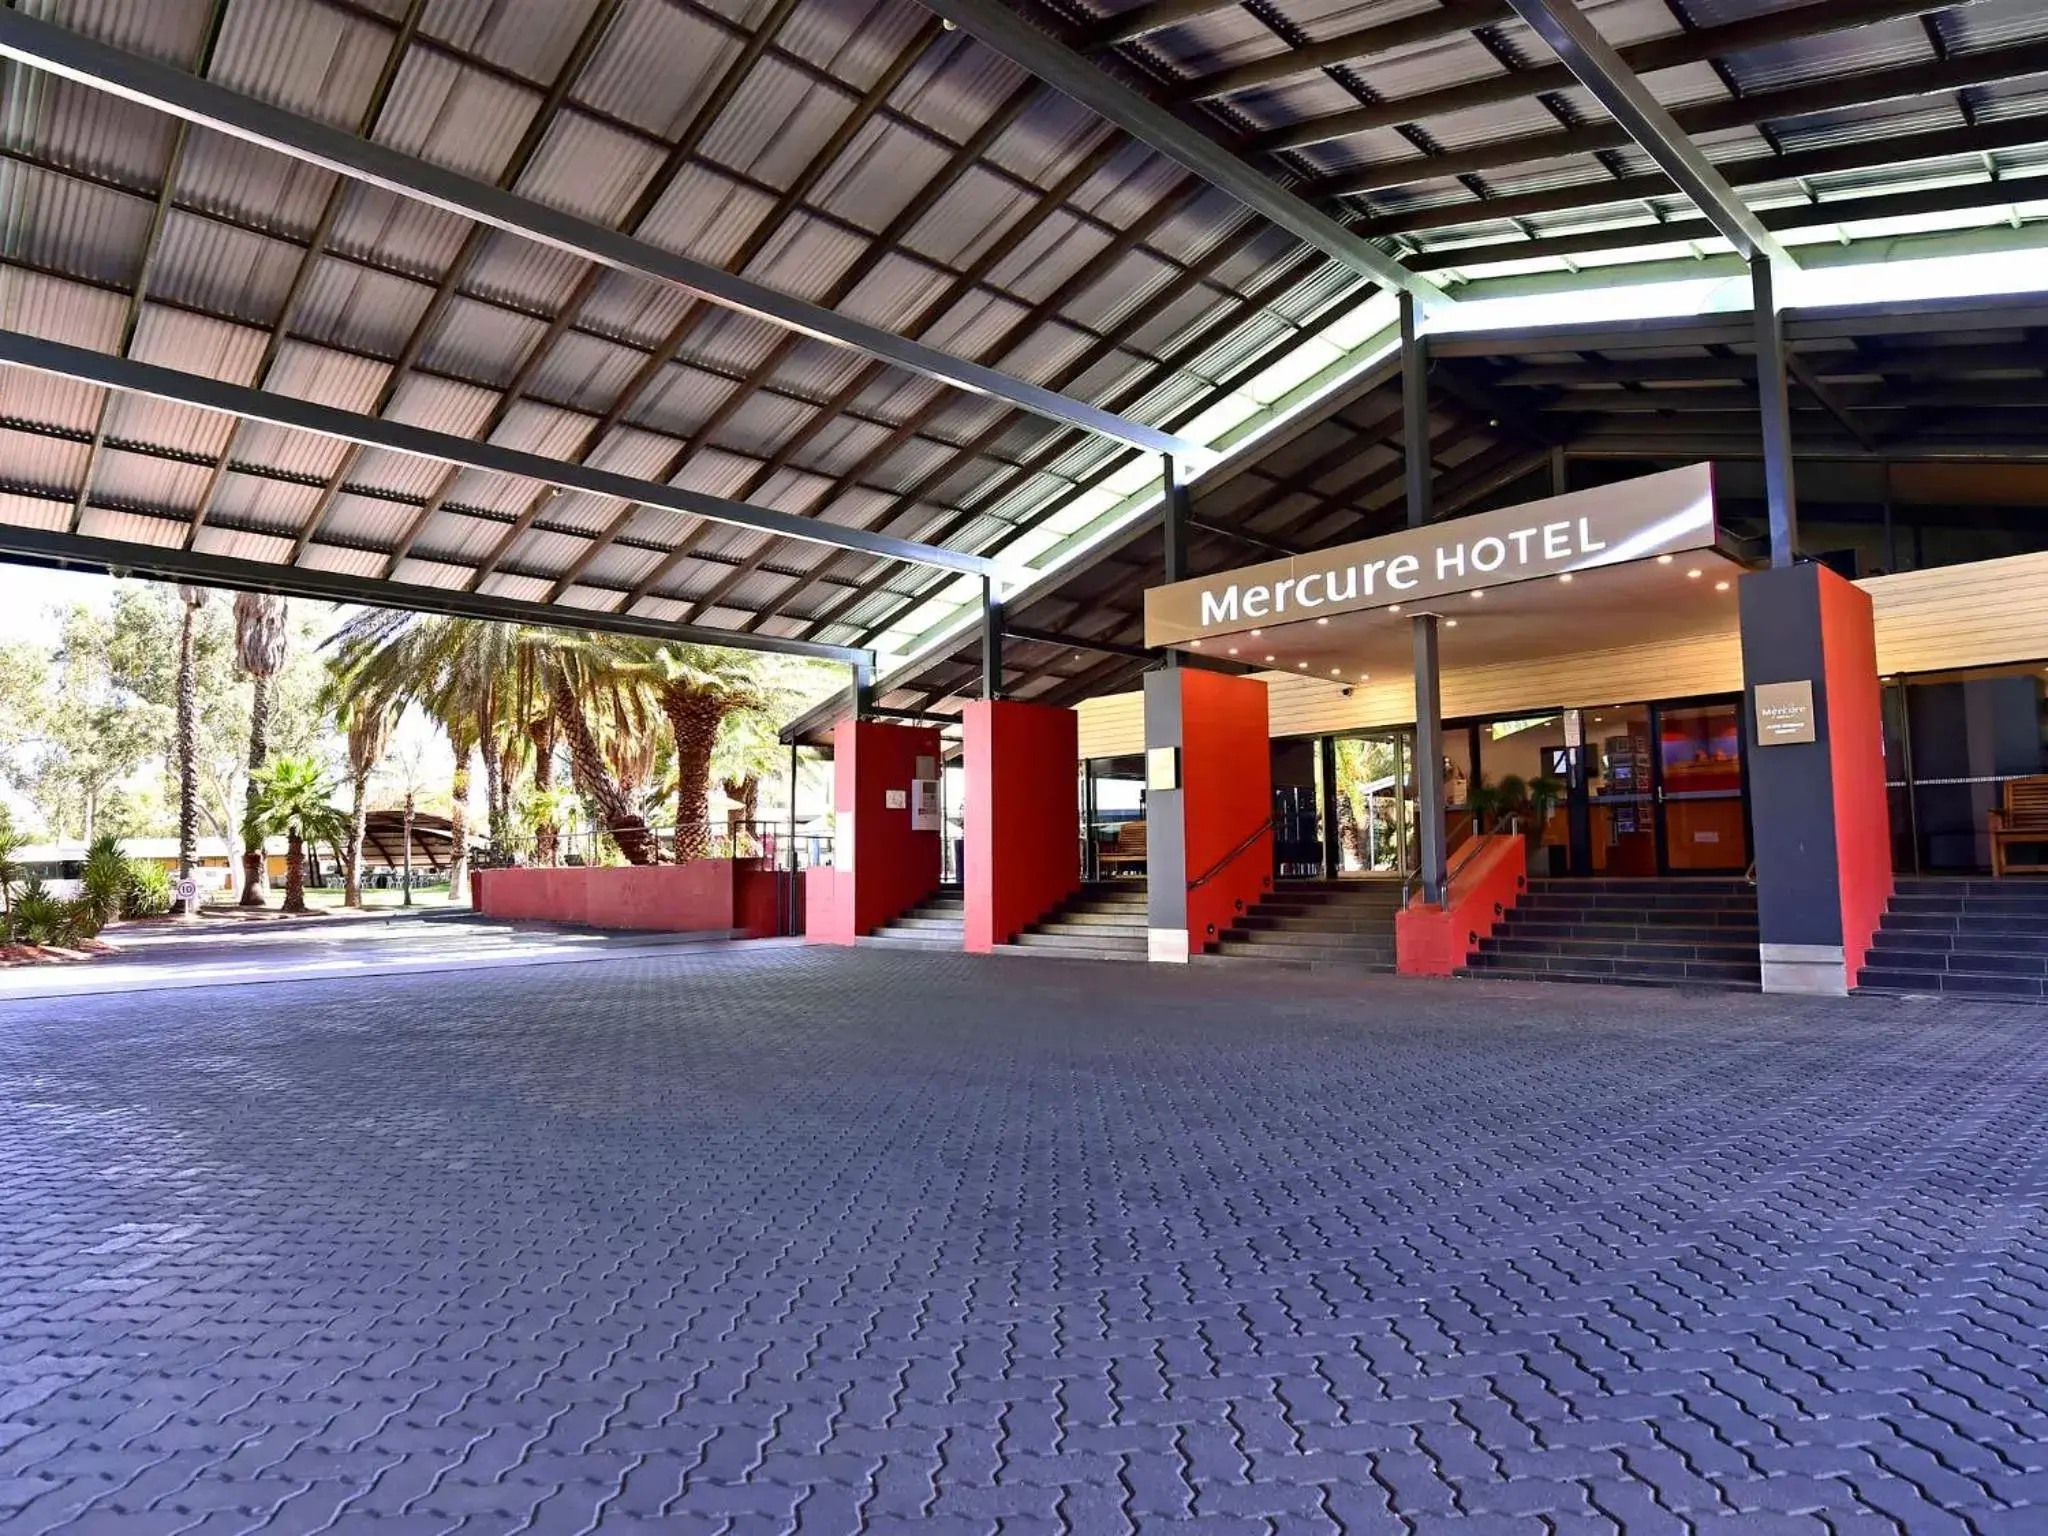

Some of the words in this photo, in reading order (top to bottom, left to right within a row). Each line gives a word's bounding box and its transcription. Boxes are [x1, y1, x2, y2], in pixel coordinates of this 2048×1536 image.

[1201, 554, 1420, 626] Mercure
[1436, 517, 1606, 580] HOTEL
[182, 885, 193, 894] 10
